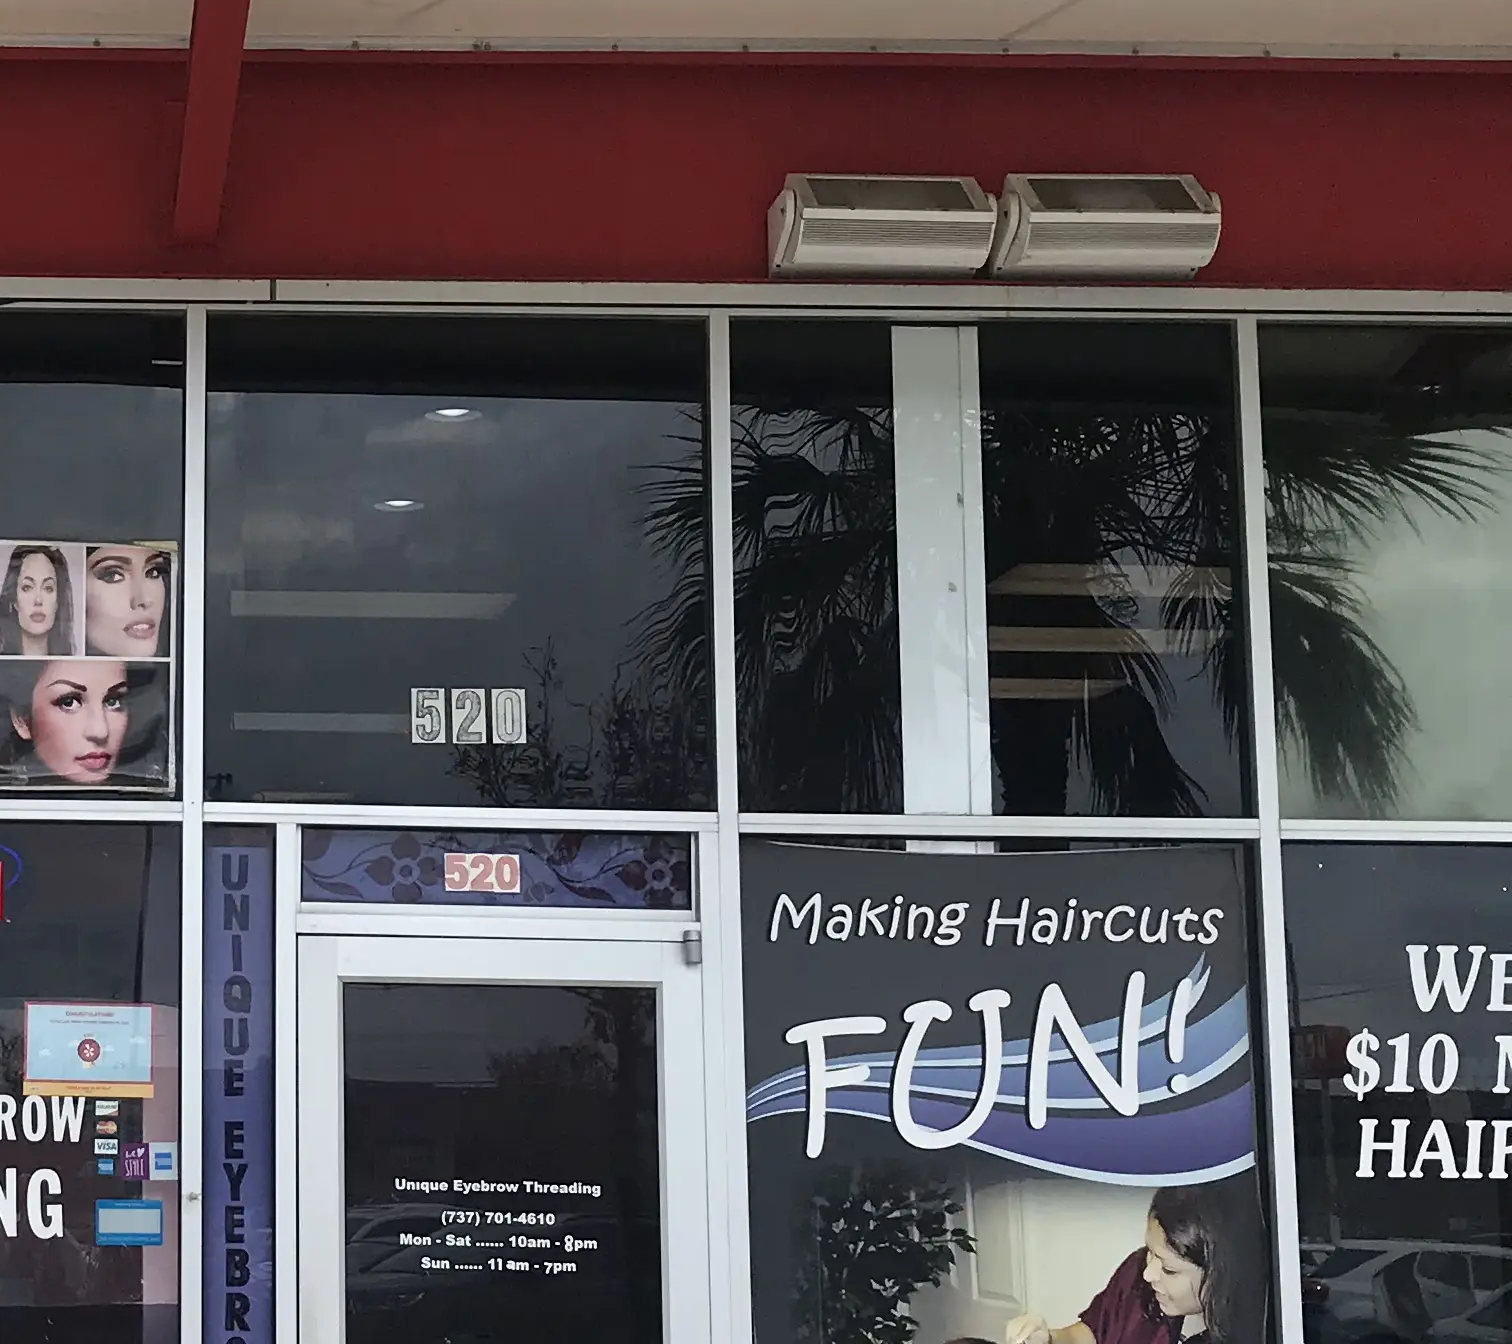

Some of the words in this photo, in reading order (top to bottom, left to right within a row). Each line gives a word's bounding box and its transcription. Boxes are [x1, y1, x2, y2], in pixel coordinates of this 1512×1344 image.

[415, 690, 525, 742] 520
[445, 853, 519, 892] 520
[769, 892, 970, 947] Making
[985, 897, 1225, 947] Haircuts
[221, 853, 252, 1098] UNIQUE
[785, 970, 1194, 1159] FUN!
[1343, 1027, 1460, 1102] $10
[96, 1142, 117, 1151] VISA
[394, 1177, 449, 1194] Unique
[453, 1179, 519, 1195] Eyebrow
[523, 1180, 602, 1197] Threading
[441, 1210, 480, 1226] (737)
[485, 1212, 556, 1225] 701-4610
[399, 1233, 432, 1246] Mon
[445, 1234, 472, 1247] Sat
[508, 1235, 551, 1248] 10am
[564, 1234, 598, 1253] 8pm
[420, 1257, 450, 1269] Sun
[543, 1261, 577, 1275] 7pm
